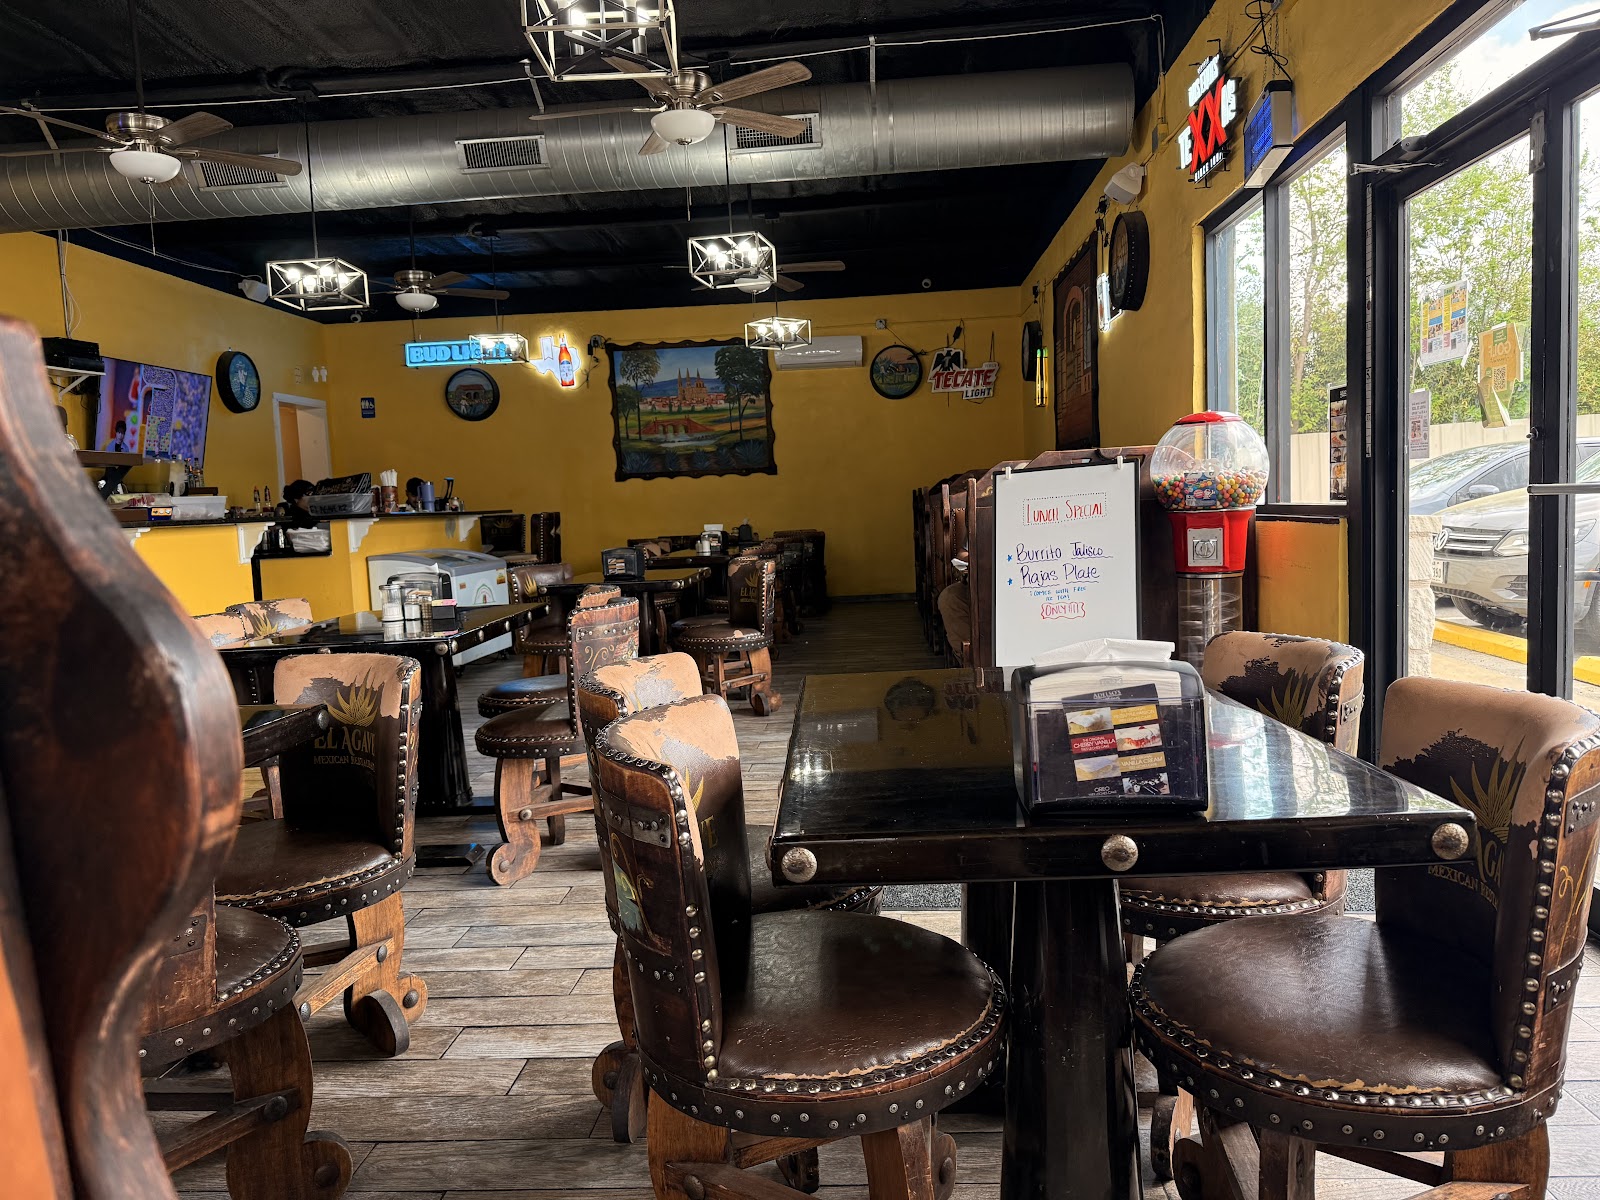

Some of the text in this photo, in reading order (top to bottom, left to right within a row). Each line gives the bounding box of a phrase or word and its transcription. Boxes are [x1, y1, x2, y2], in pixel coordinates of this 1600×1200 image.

[409, 346, 451, 363] BUD
[932, 368, 996, 388] TECATE
[965, 387, 992, 398] LIGHT
[1026, 500, 1104, 524] LUNCH SPECIAL
[1015, 541, 1104, 562] Burrito Jalisco
[1020, 563, 1100, 587] Rajas Plate
[1073, 738, 1116, 749] CHERRY VANILLA
[313, 755, 349, 765] MEXICAN
[1094, 785, 1110, 793] OREO
[1428, 865, 1477, 890] MEXICAN
